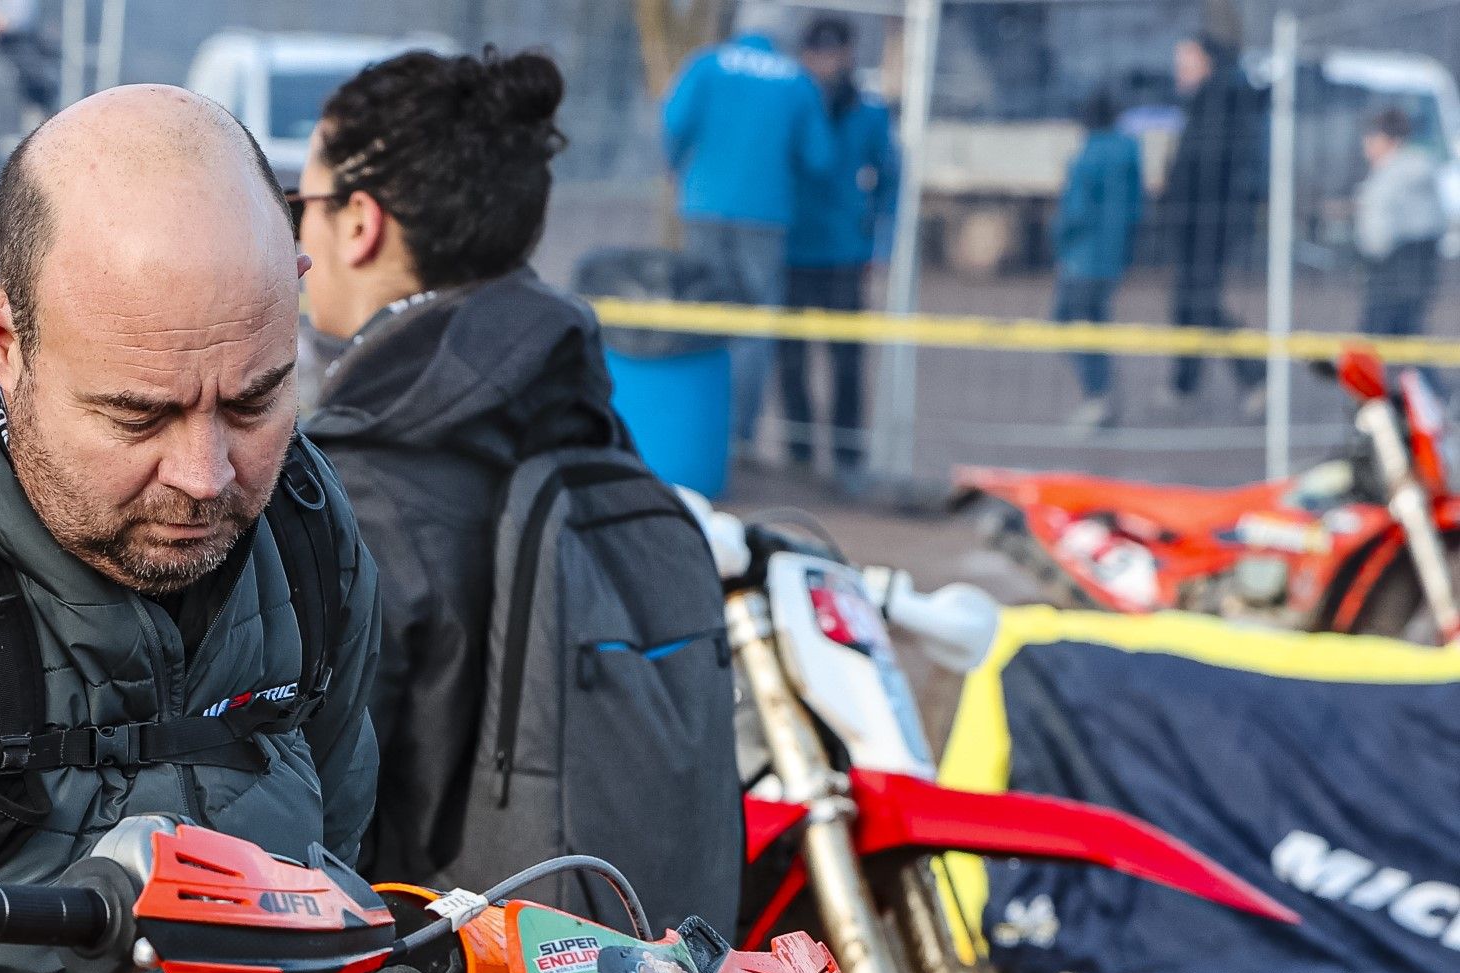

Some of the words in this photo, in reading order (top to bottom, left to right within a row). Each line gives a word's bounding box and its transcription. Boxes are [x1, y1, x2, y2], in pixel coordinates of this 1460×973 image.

[271, 892, 321, 916] UFO
[540, 938, 598, 955] SUPER
[537, 950, 599, 970] ENDUR
